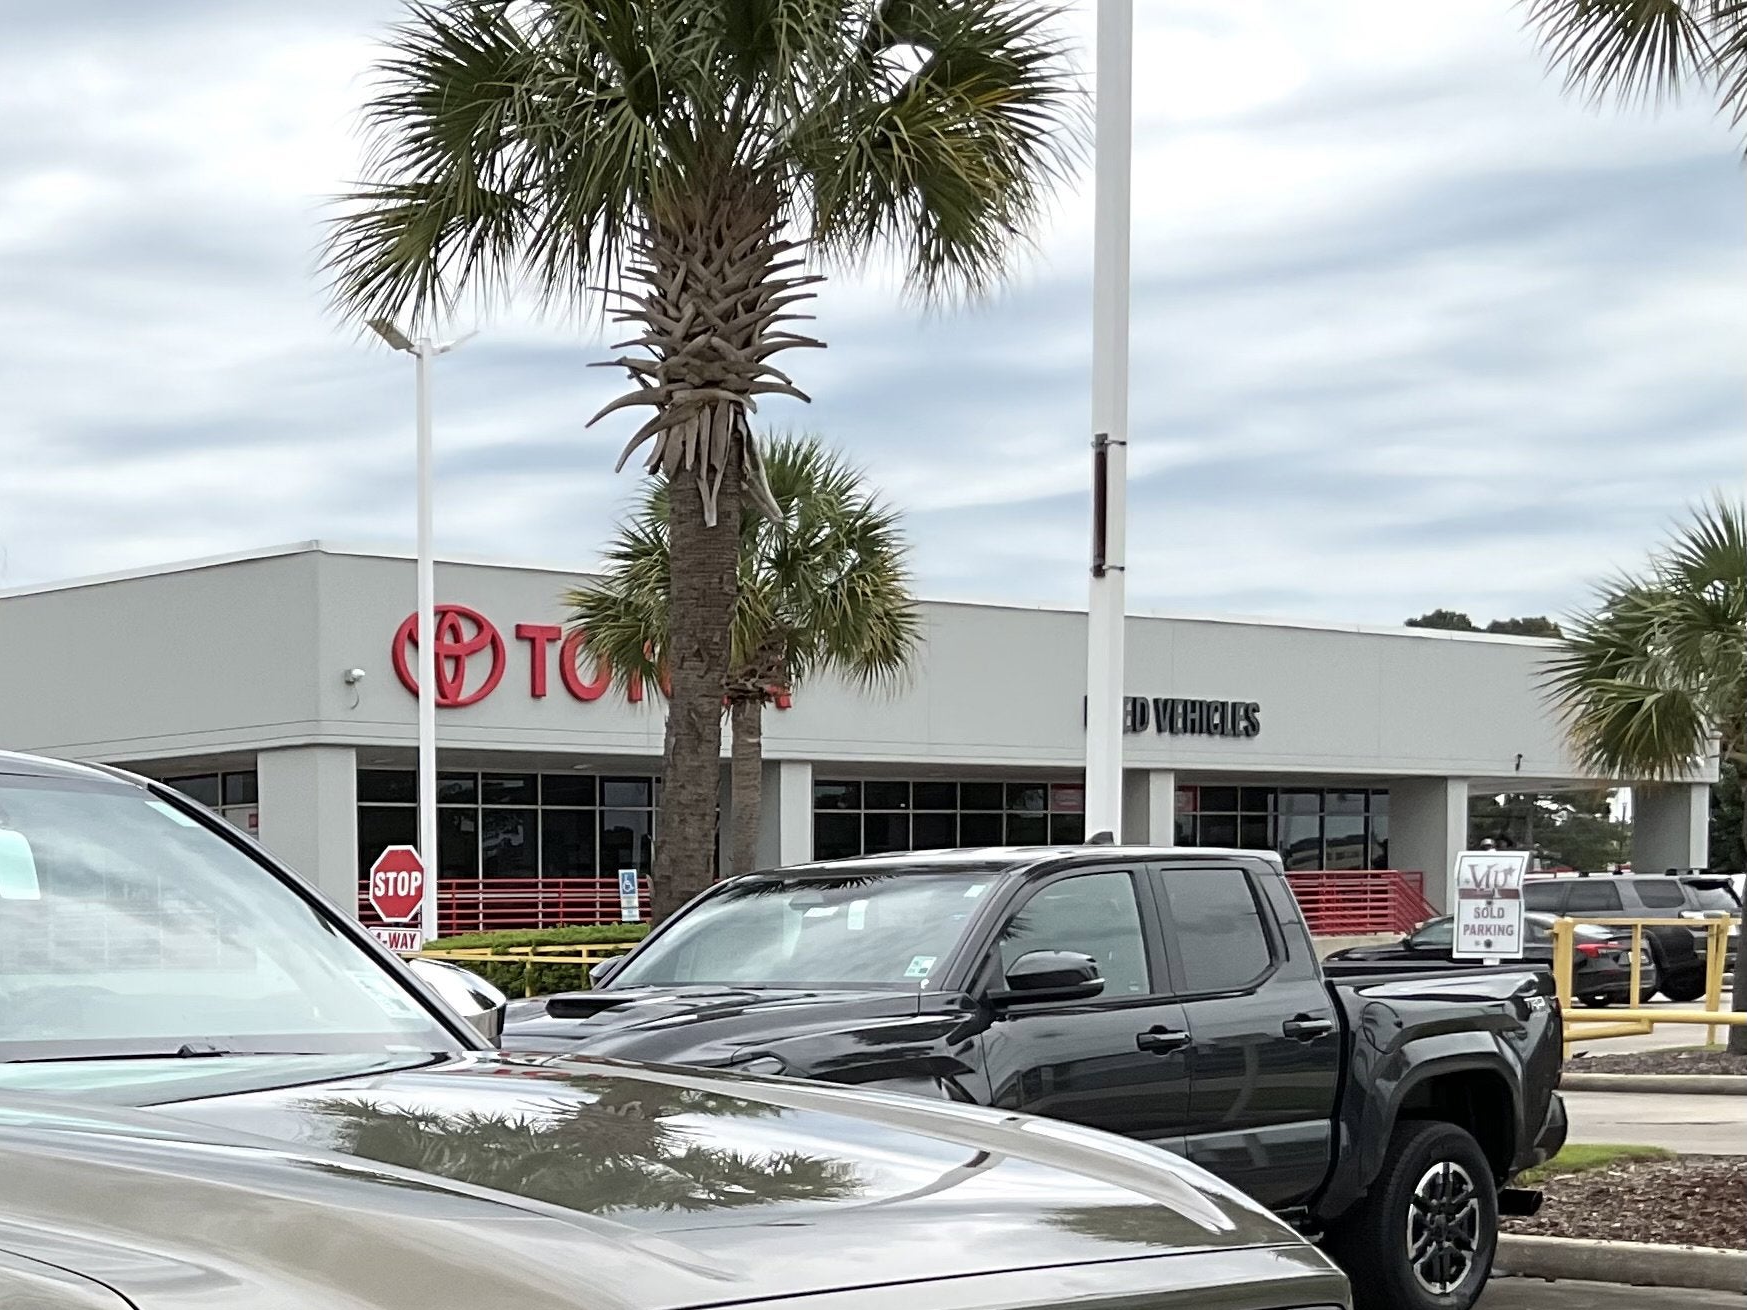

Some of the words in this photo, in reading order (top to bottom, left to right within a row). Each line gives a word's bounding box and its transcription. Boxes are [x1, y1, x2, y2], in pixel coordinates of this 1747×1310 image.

[1153, 698, 1260, 737] VEHICLES
[374, 871, 422, 897] STOP
[1474, 907, 1505, 919] SOLD
[1463, 924, 1514, 937] PARKING
